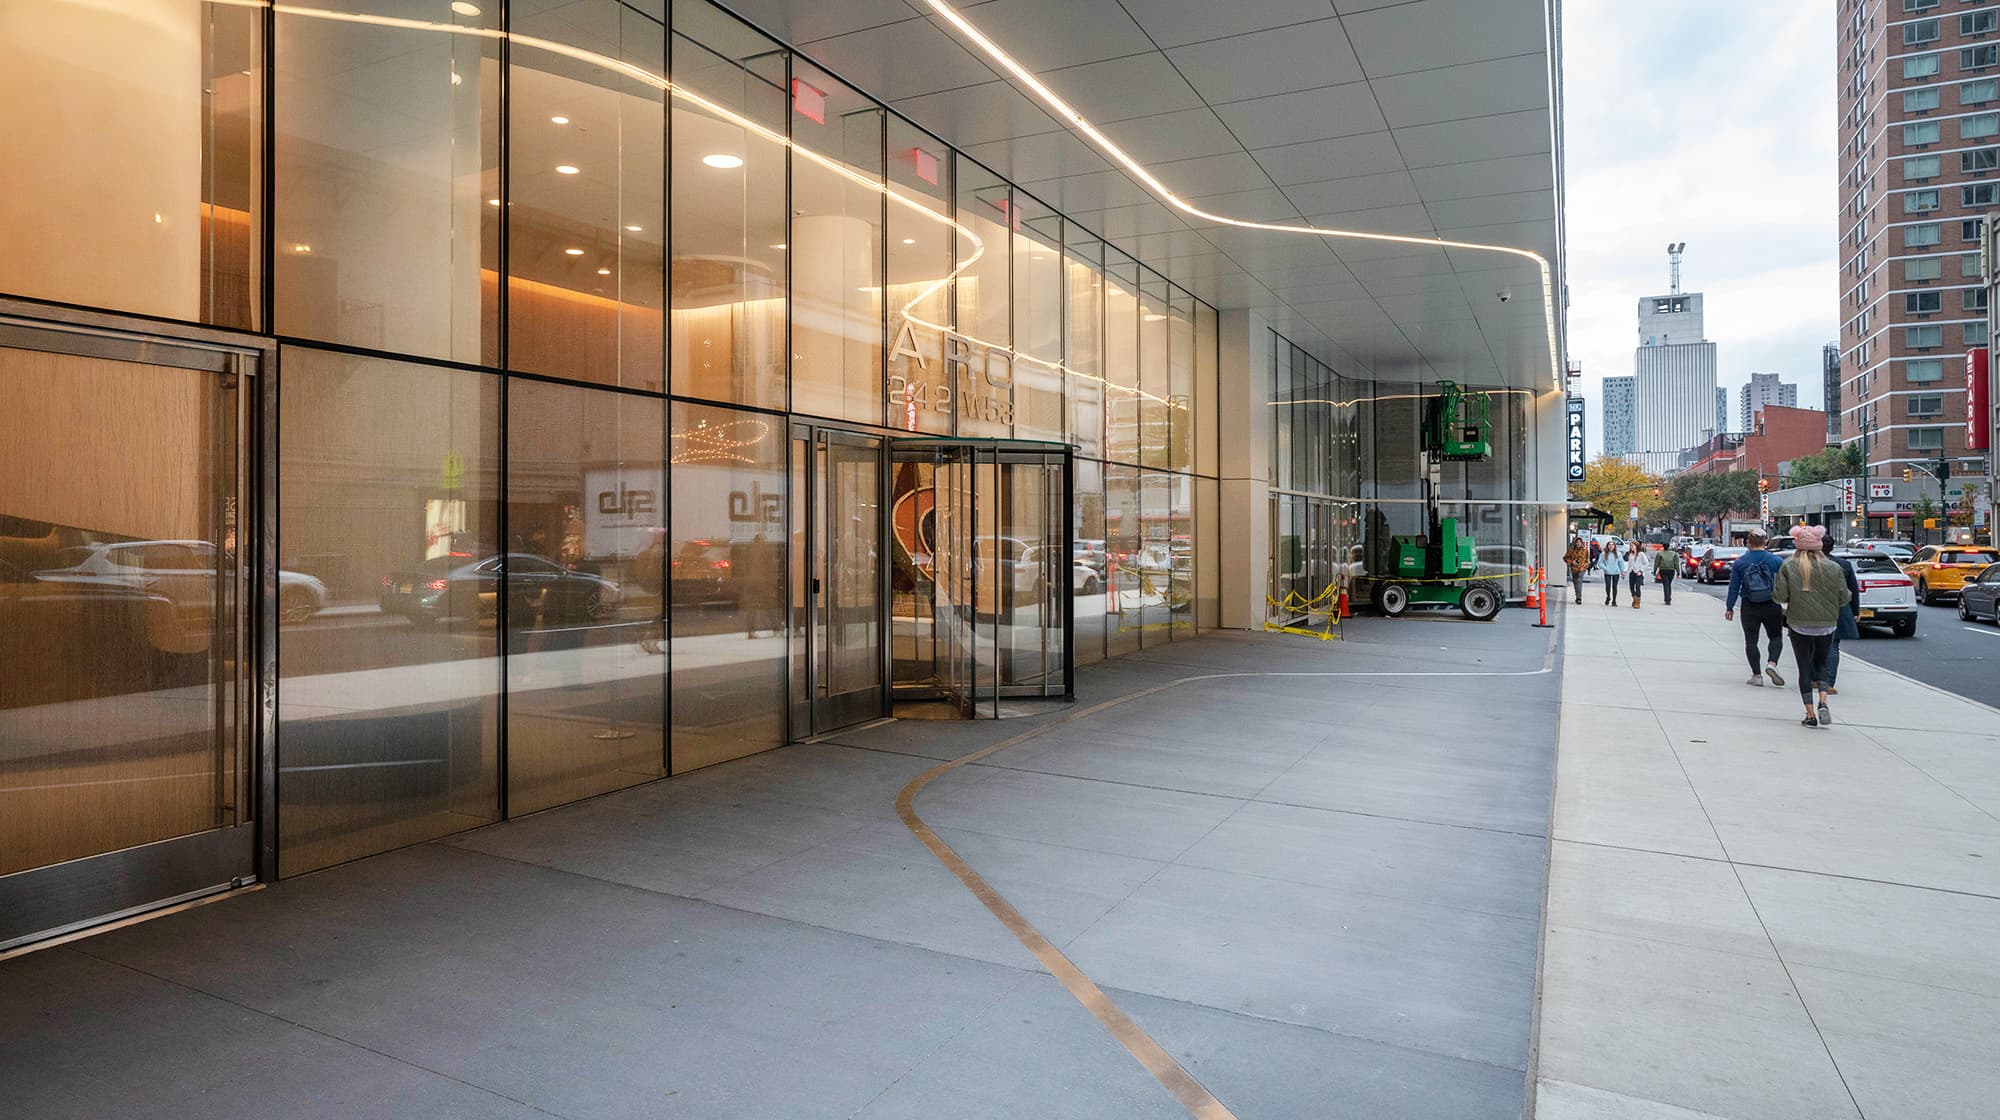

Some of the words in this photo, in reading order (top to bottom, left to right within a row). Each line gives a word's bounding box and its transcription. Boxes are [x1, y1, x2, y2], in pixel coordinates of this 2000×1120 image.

[888, 320, 1015, 390] ARO
[887, 375, 951, 415] 242
[1570, 413, 1582, 464] PARK
